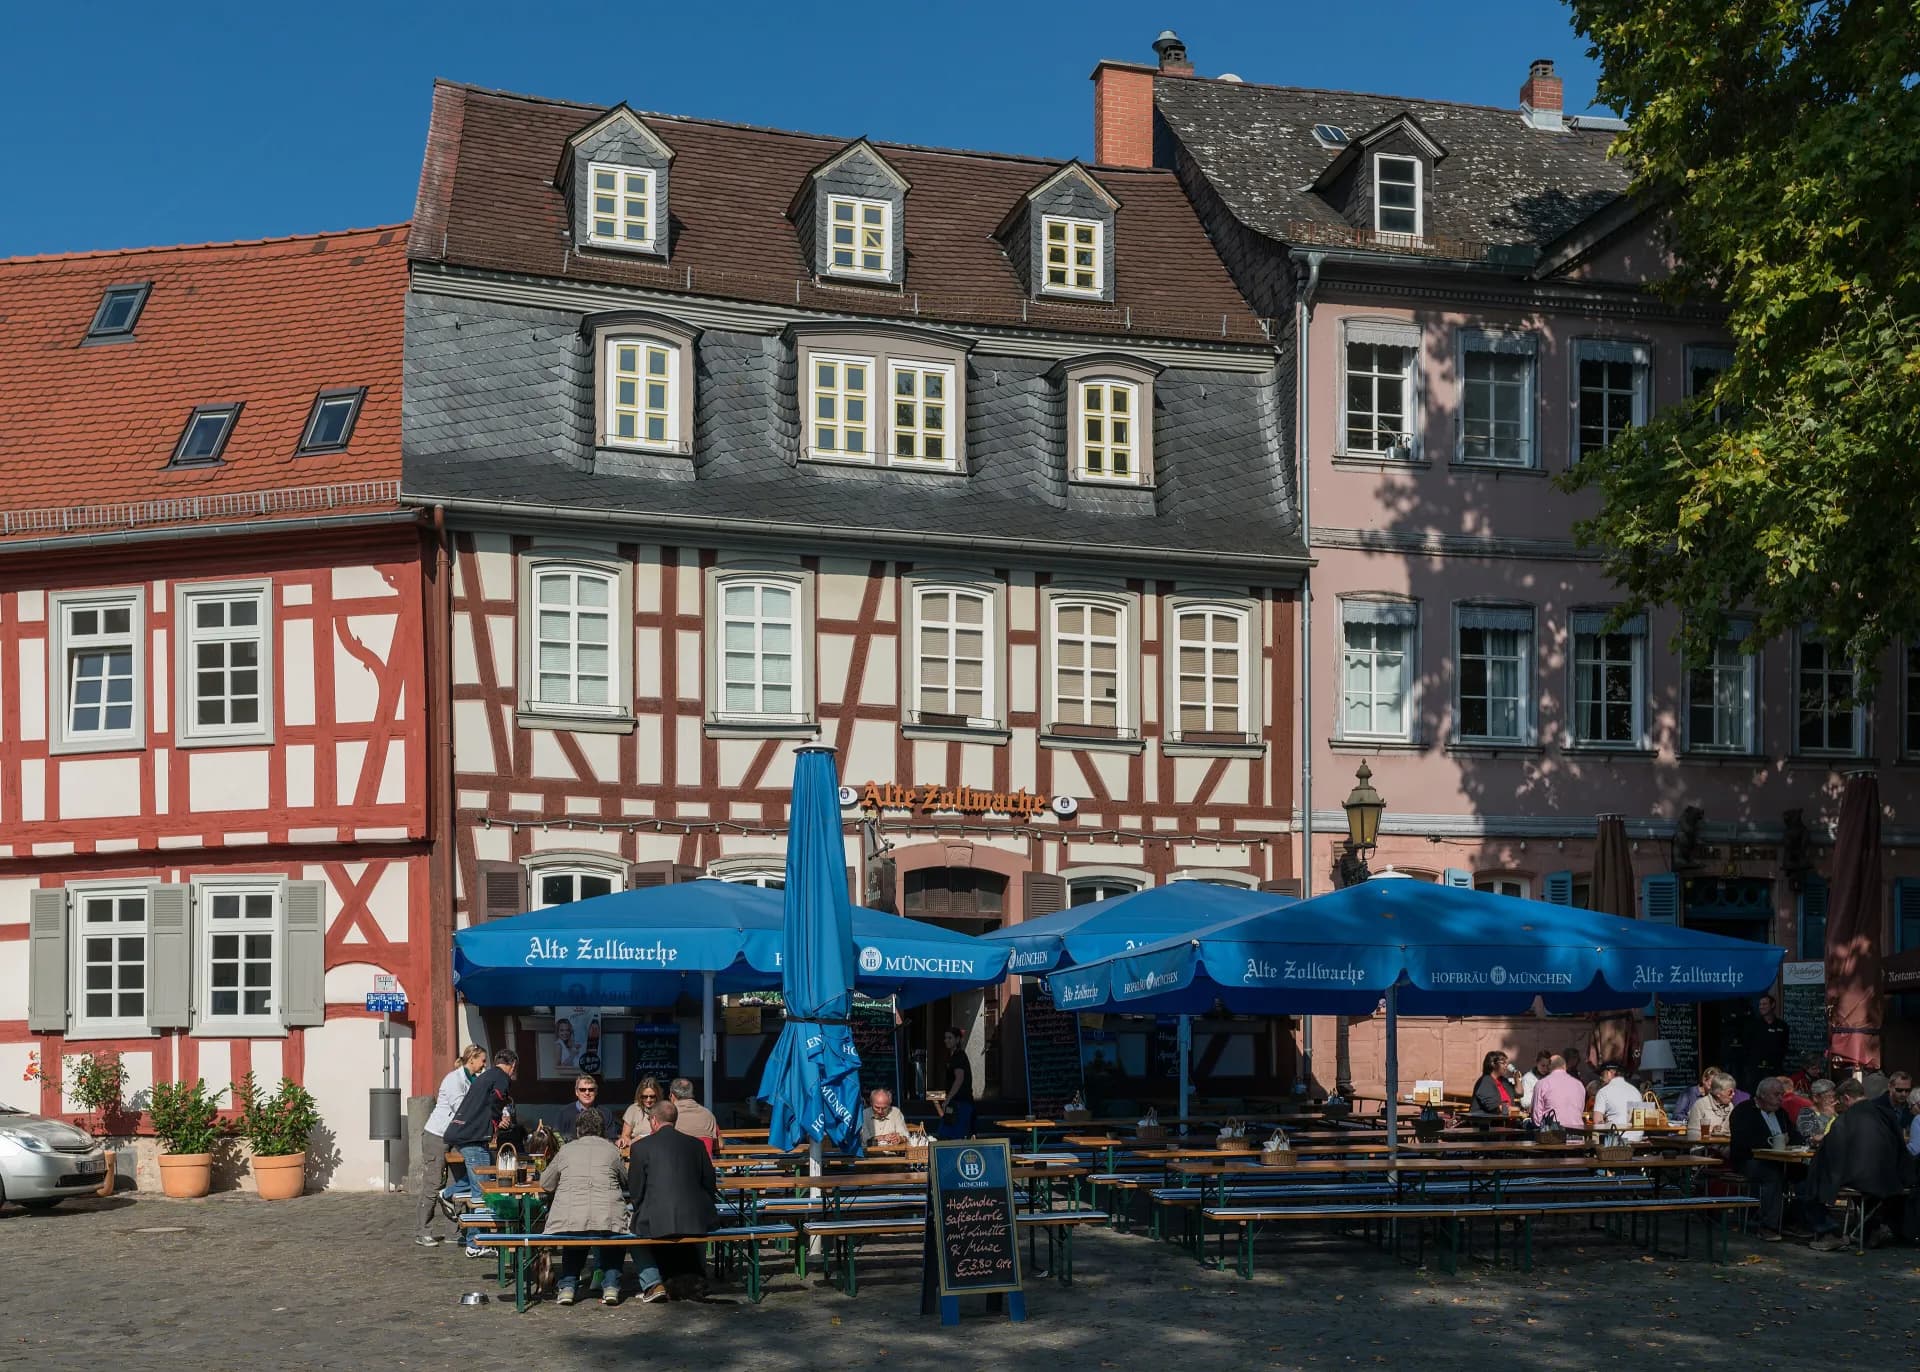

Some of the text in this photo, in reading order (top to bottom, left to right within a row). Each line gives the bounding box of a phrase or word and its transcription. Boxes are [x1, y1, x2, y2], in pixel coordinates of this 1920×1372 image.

[861, 780, 917, 808] Alte
[922, 784, 1046, 819] Zollwache
[525, 936, 678, 967] Alte Zollwache
[1015, 951, 1048, 967] MÜNCHEN
[885, 955, 975, 974] MÜNCHEN
[1243, 958, 1365, 986] Alte Zollwache
[1431, 971, 1572, 985] HOFBRÄU MÜNCHEN
[1632, 965, 1744, 989] Alte Zollwache
